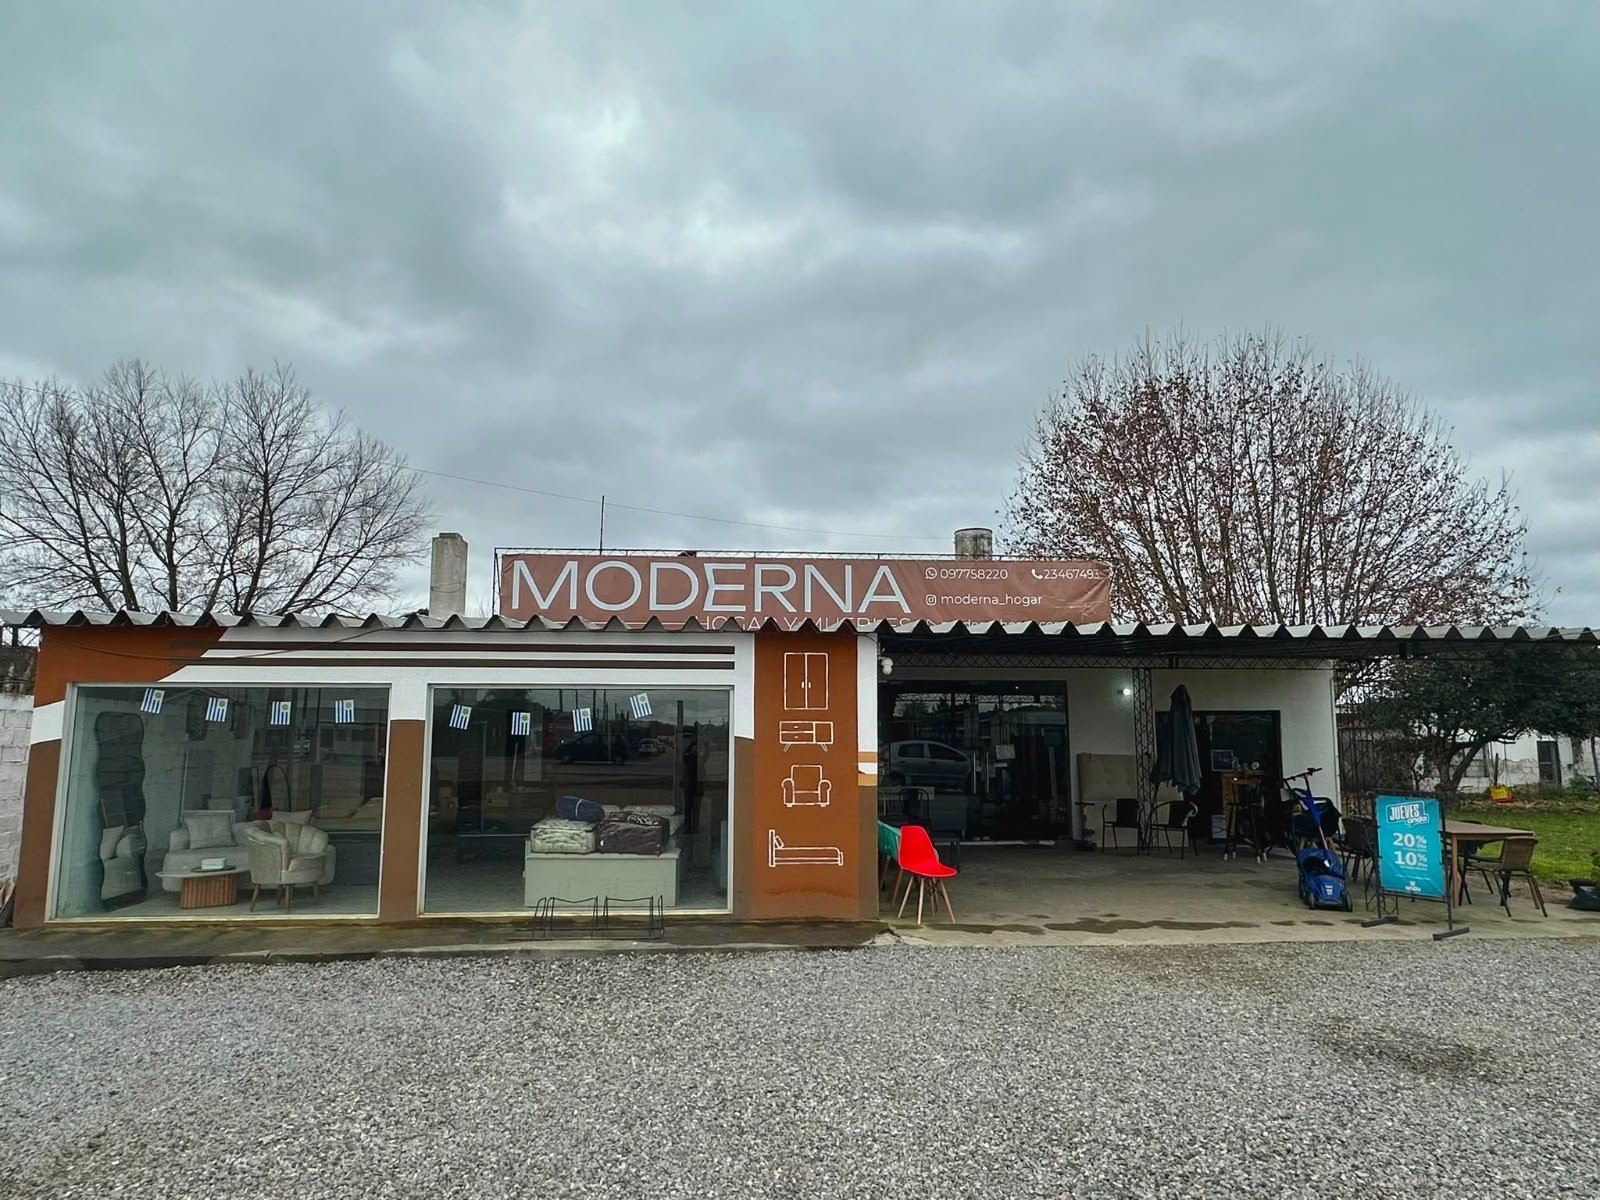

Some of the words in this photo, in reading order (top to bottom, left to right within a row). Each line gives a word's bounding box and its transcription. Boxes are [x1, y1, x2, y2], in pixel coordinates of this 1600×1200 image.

[940, 568, 1009, 580] 097758220
[510, 560, 912, 613] MODERNA
[941, 594, 1043, 608] moderna_hogar
[1389, 803, 1420, 821] JUEVES
[1392, 832, 1427, 848] 20%
[1393, 850, 1428, 866] 10%
